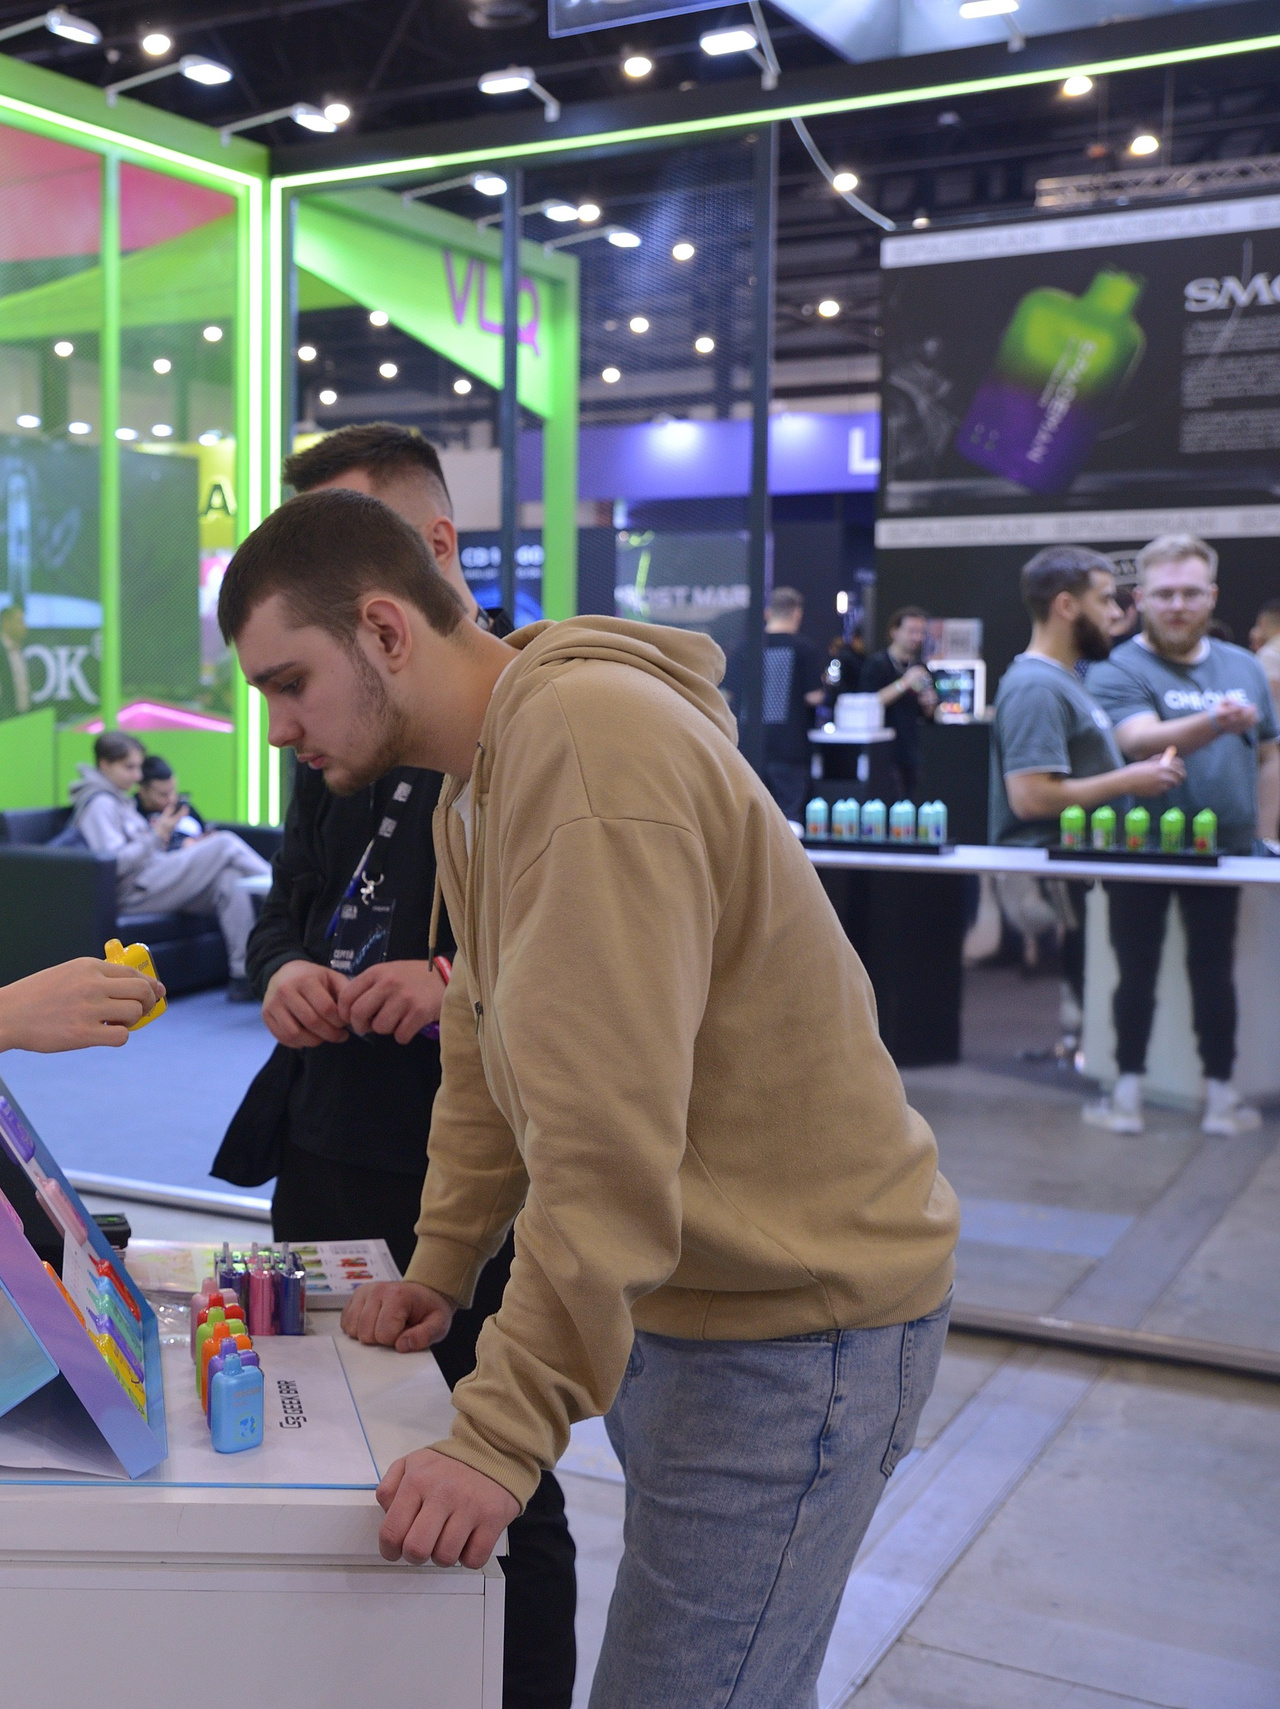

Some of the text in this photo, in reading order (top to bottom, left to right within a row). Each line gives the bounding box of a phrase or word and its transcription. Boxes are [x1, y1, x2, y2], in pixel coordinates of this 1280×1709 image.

[1184, 271, 1280, 312] SM
[848, 428, 881, 475] L
[201, 476, 236, 517] A
[277, 1380, 303, 1414] GEEK BAR
